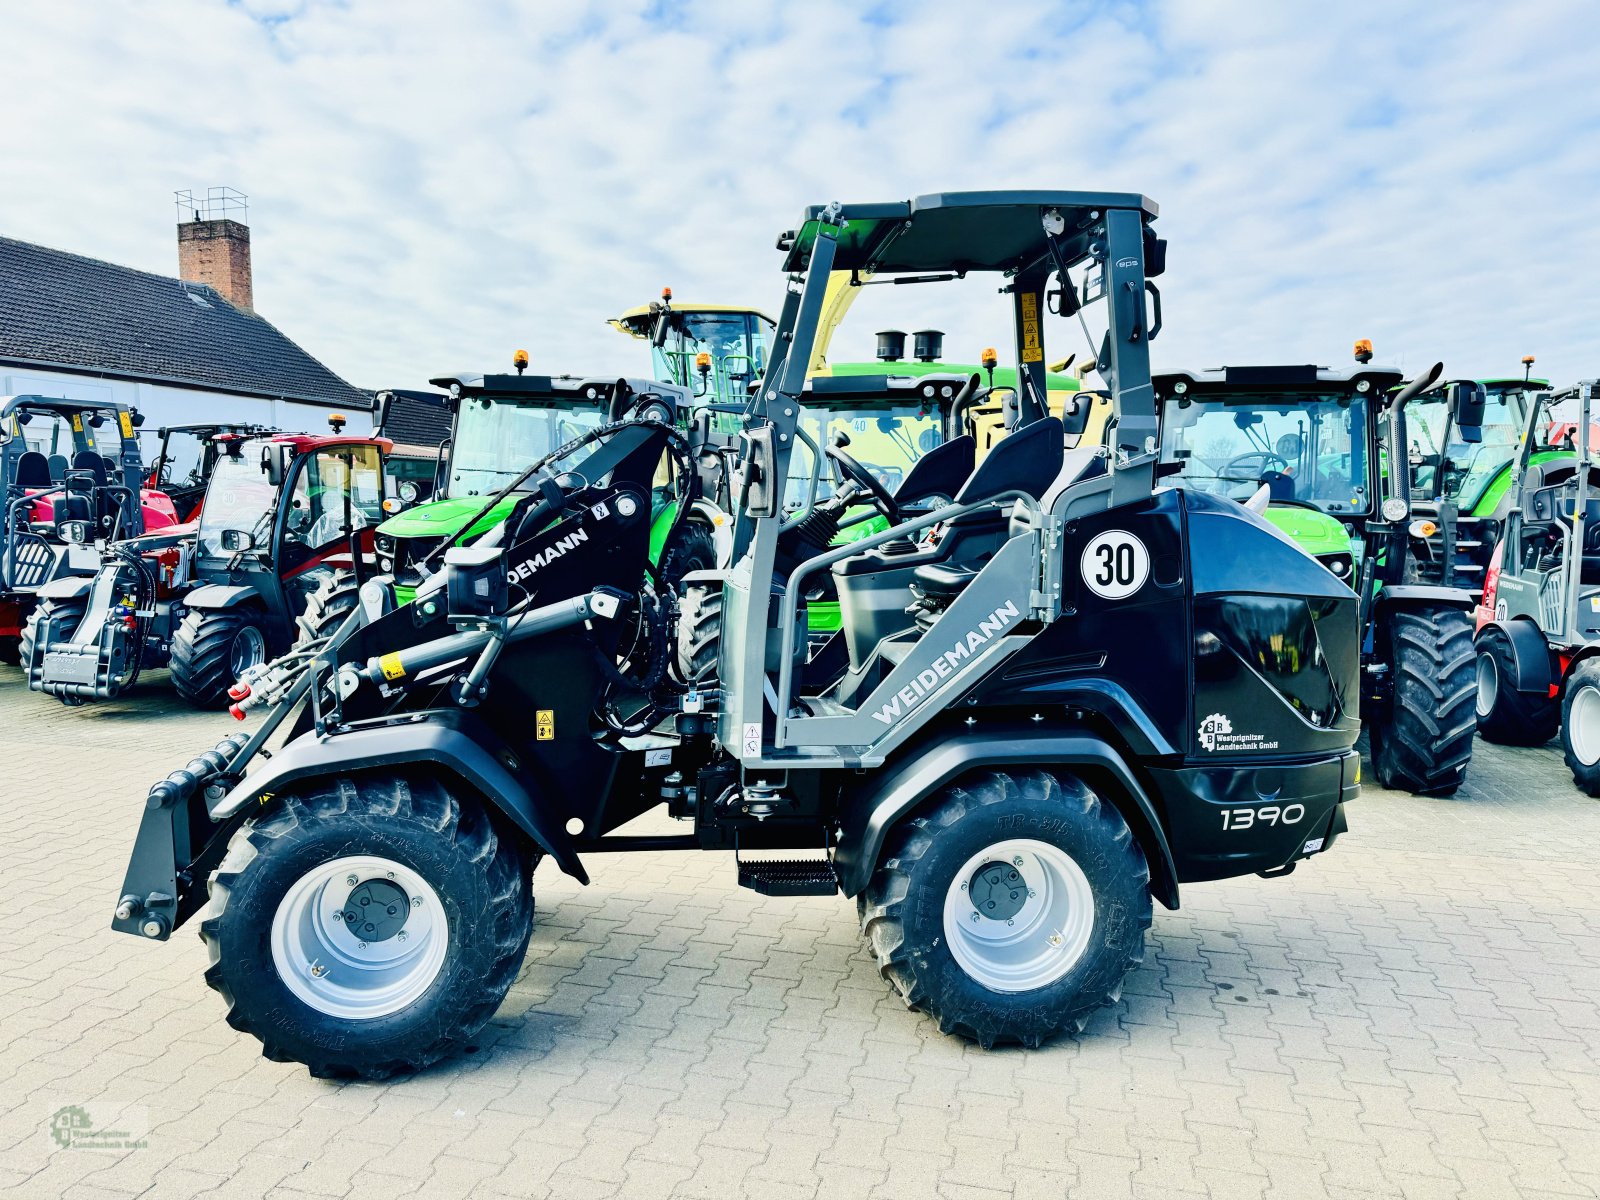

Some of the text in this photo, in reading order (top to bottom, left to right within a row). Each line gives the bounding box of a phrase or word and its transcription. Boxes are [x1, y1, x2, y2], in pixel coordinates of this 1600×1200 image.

[1118, 260, 1139, 268] eps
[854, 420, 866, 432] 40
[1095, 543, 1135, 587] 30
[1497, 604, 1506, 621] 20
[871, 599, 1020, 725] WEIDEMANN
[1216, 734, 1264, 743] Westprignitzer
[1216, 741, 1279, 751] Landtechnik GmbH
[1220, 803, 1306, 831] 1390
